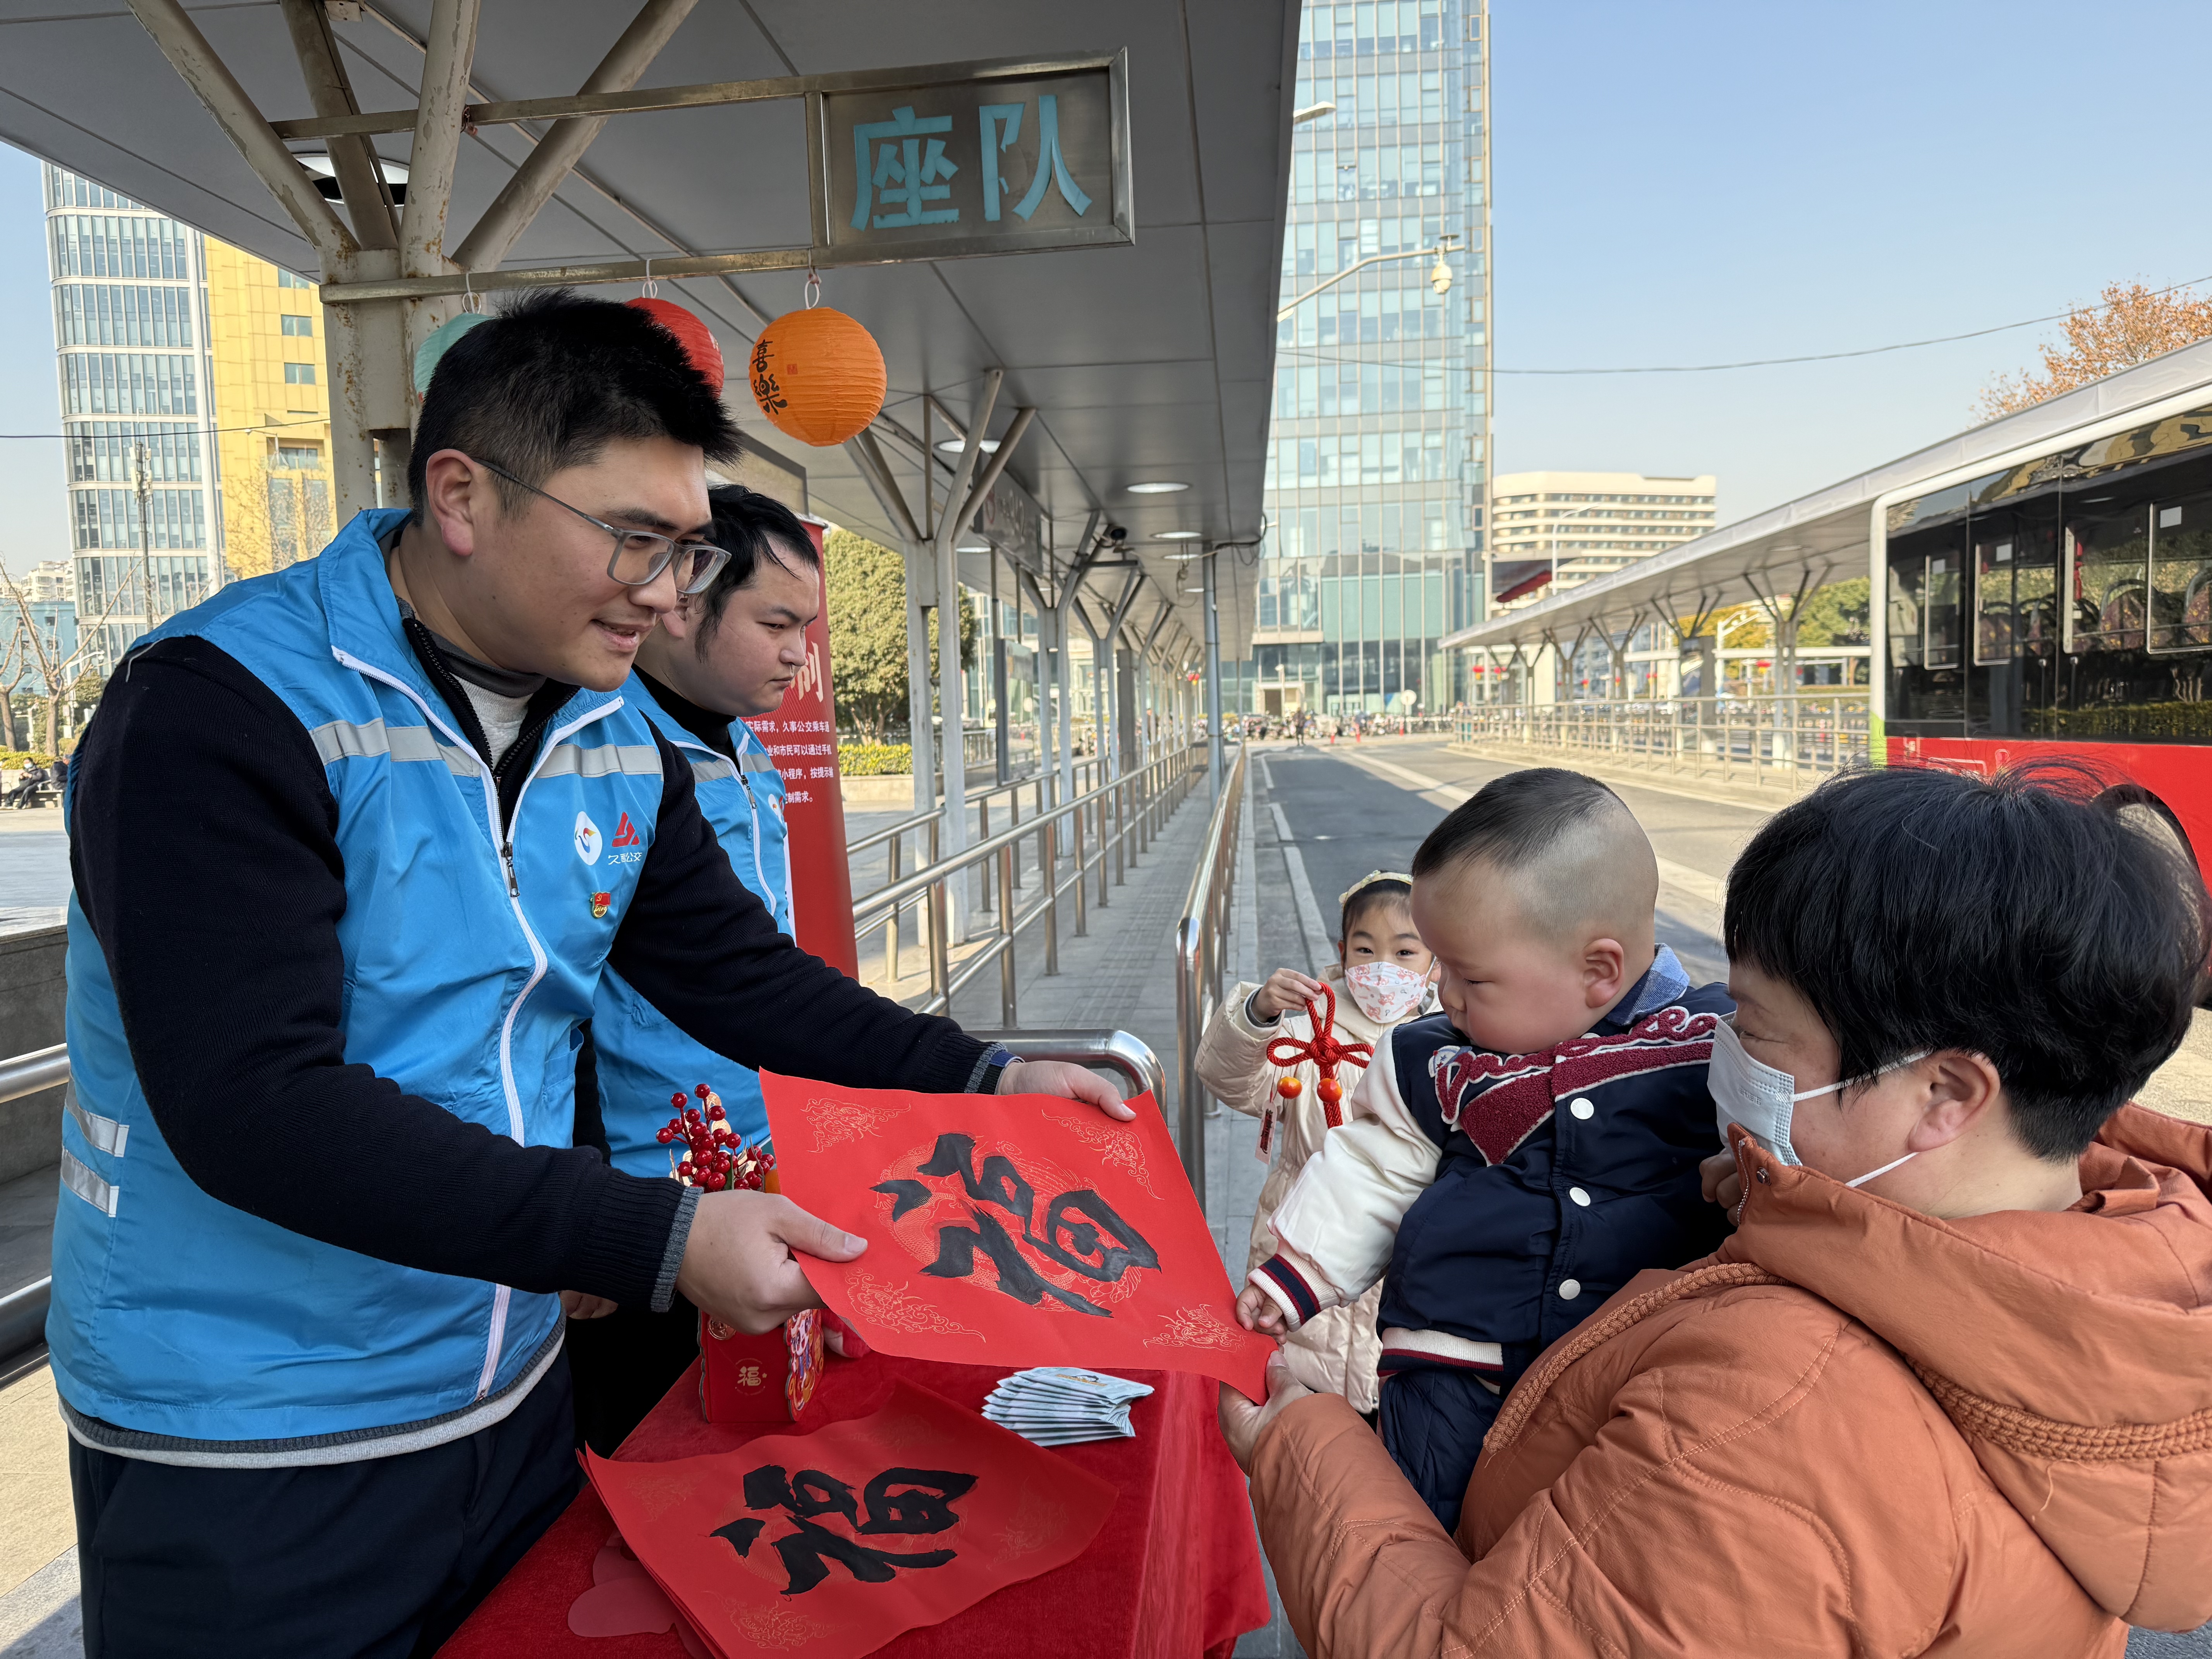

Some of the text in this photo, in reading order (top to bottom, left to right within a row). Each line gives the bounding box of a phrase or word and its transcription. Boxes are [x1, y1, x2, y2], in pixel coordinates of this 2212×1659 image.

[850, 94, 1092, 231] 座队
[766, 744, 832, 756] 业和市民可以通过手机
[737, 1366, 761, 1386] 福
